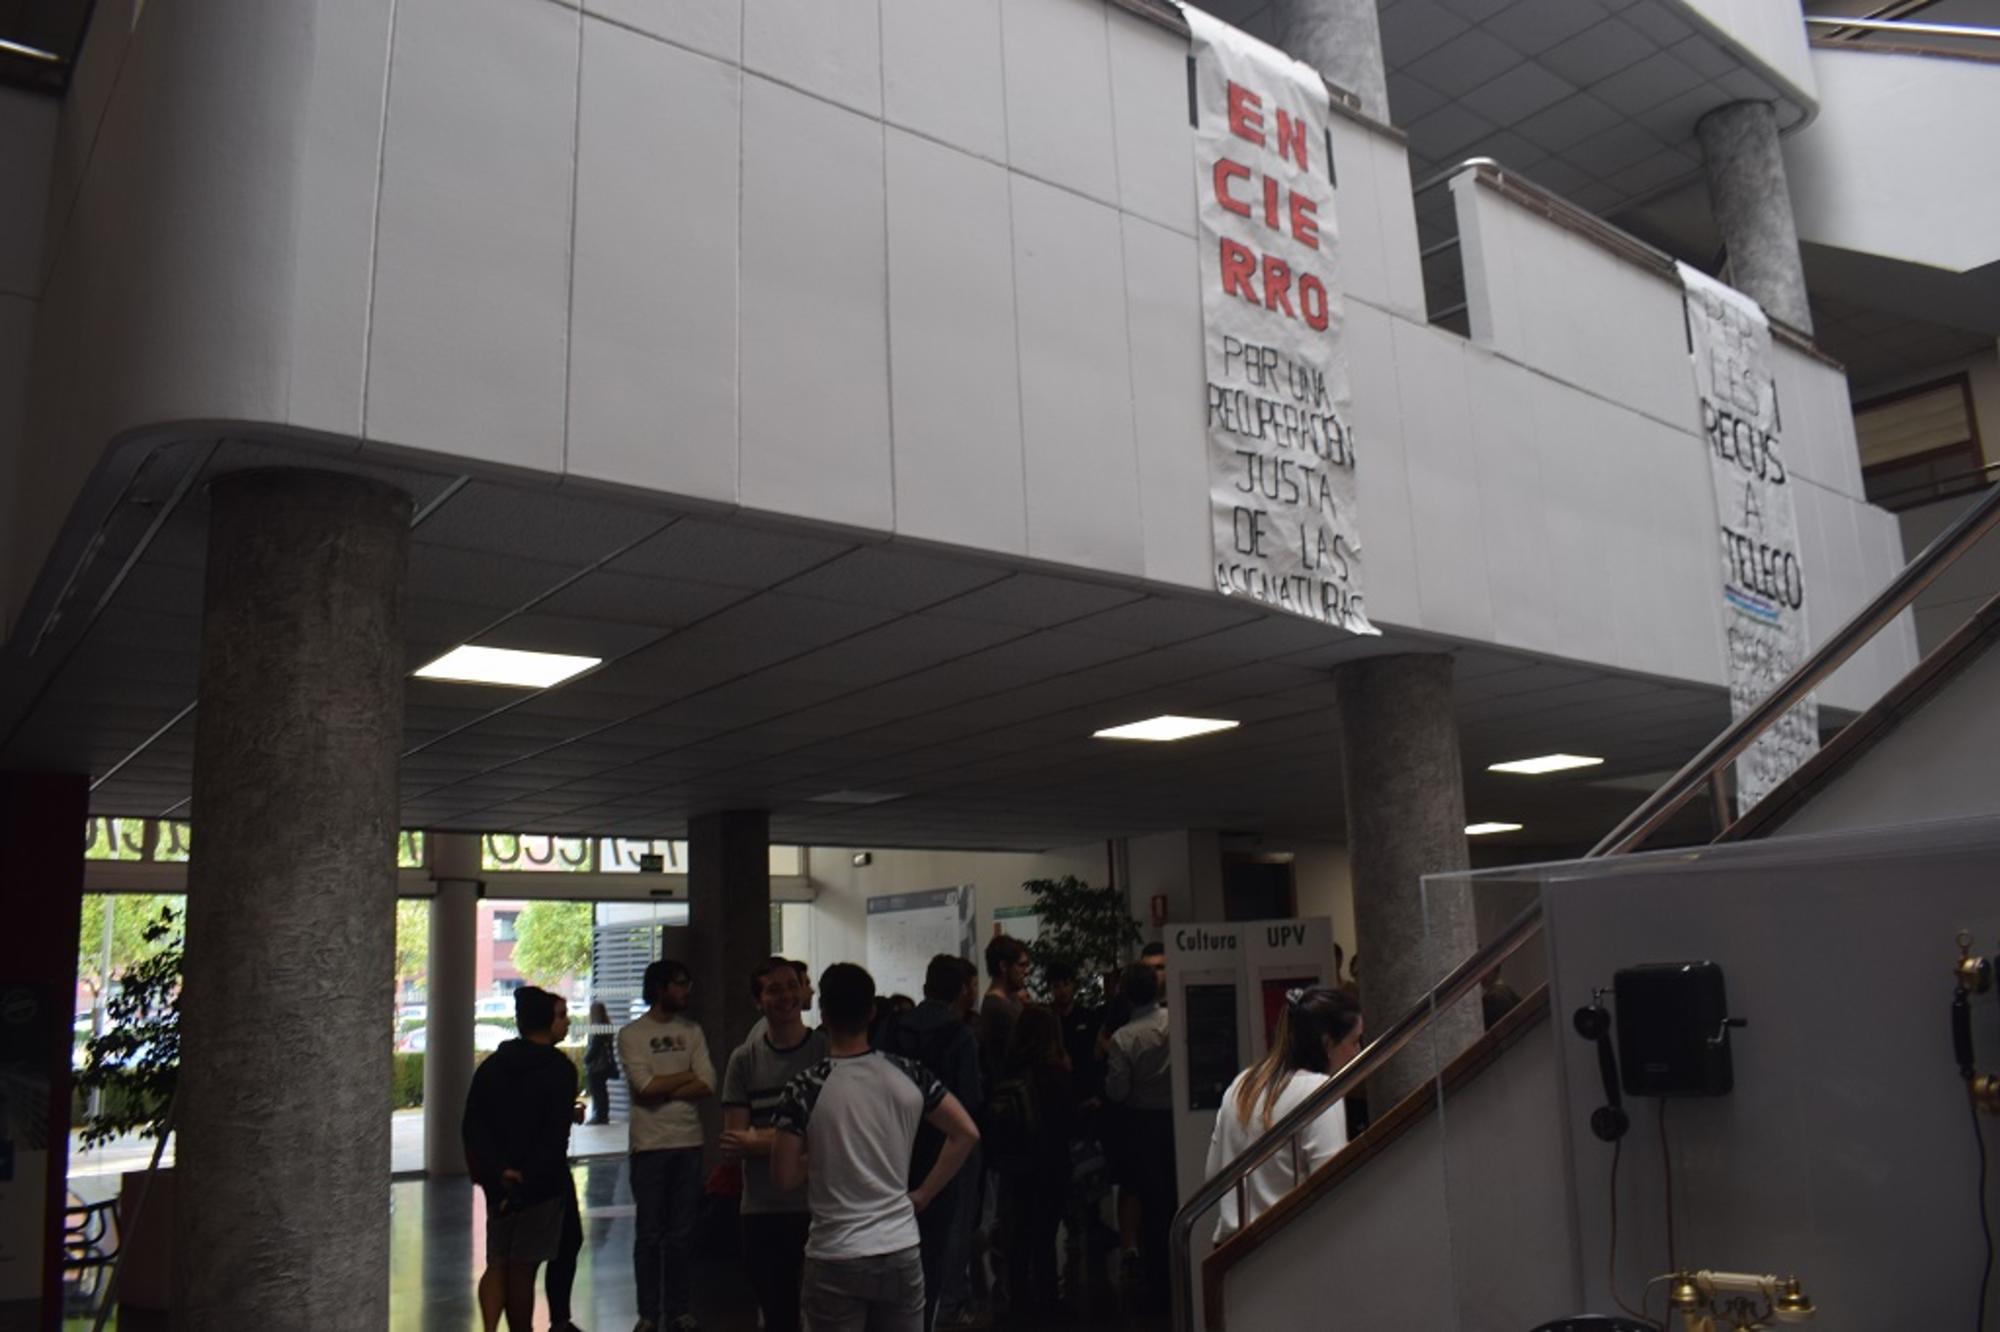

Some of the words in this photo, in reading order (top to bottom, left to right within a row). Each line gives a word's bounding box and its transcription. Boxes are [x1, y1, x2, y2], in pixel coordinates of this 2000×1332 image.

[1227, 78, 1309, 173] EN
[1213, 157, 1319, 251] CIE
[1219, 235, 1328, 332] RRO
[1287, 359, 1331, 411] UNA
[1235, 449, 1338, 519] JUSTA
[1745, 480, 1764, 534] A
[1233, 506, 1268, 558] DE
[1300, 523, 1350, 582] LAS
[1722, 524, 1803, 610] TELECO
[1176, 928, 1237, 951] Cultura
[1267, 924, 1306, 948] UPV
